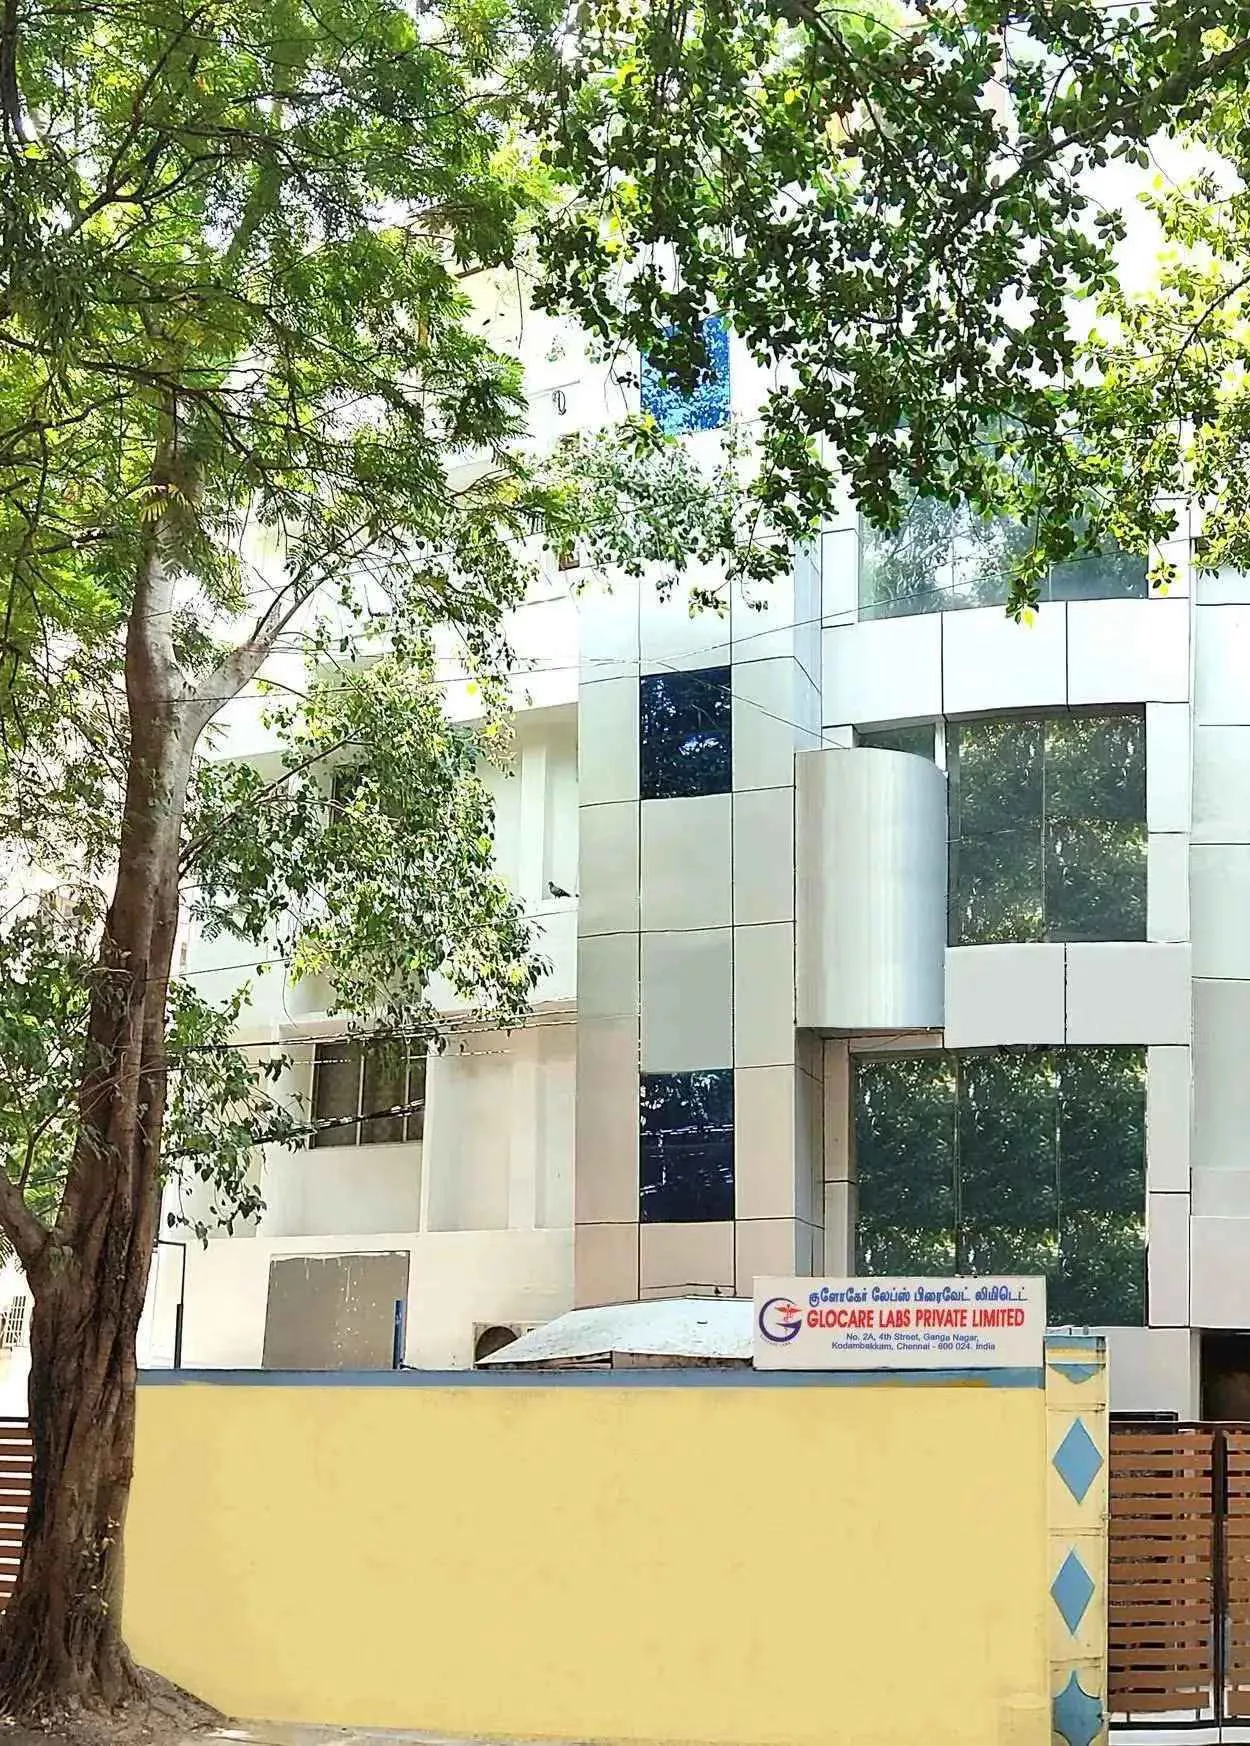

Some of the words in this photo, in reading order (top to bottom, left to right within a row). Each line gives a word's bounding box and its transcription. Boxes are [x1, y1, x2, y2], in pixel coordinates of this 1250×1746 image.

[872, 1286, 910, 1302] லேப்ஸ்
[914, 1286, 970, 1304] பிரைவேட்
[807, 1310, 874, 1328] GLOCARE
[879, 1310, 910, 1328] LABS
[915, 1309, 967, 1327] PRIVATE
[972, 1308, 1025, 1327] LIMITED
[846, 1333, 860, 1341] No.
[863, 1333, 876, 1341] 2A,
[879, 1333, 892, 1341] 4th
[894, 1333, 920, 1342] Street,
[923, 1333, 950, 1343] Ganga
[953, 1334, 979, 1342] Nagar,
[832, 1342, 893, 1350] Kodambakkam,
[896, 1342, 930, 1350] Chennai
[938, 1342, 953, 1350] 600
[976, 1342, 996, 1350] India
